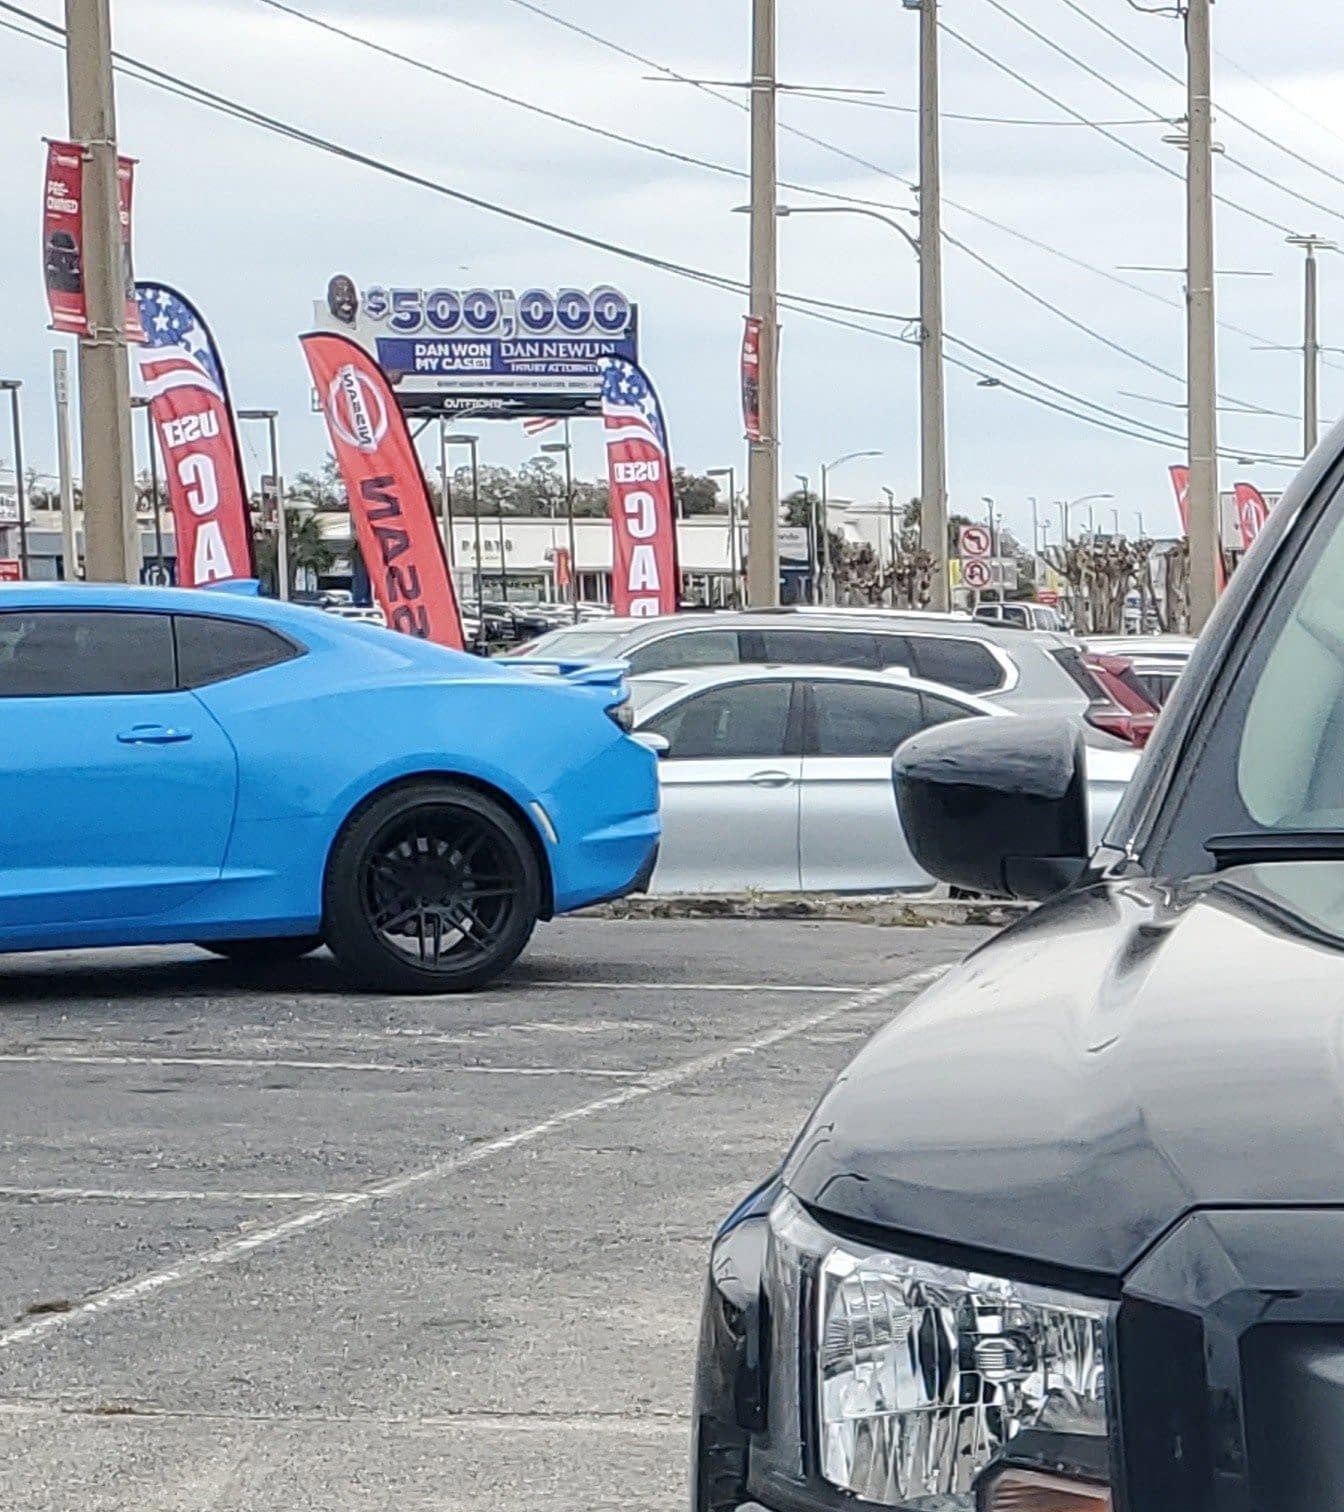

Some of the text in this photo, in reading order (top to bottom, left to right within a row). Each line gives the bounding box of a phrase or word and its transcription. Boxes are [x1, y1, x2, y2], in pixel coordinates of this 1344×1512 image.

[364, 285, 631, 341] $500,000
[415, 343, 492, 357] DAN WON
[501, 342, 616, 358] DAN NEWLIN
[415, 358, 440, 371] MY
